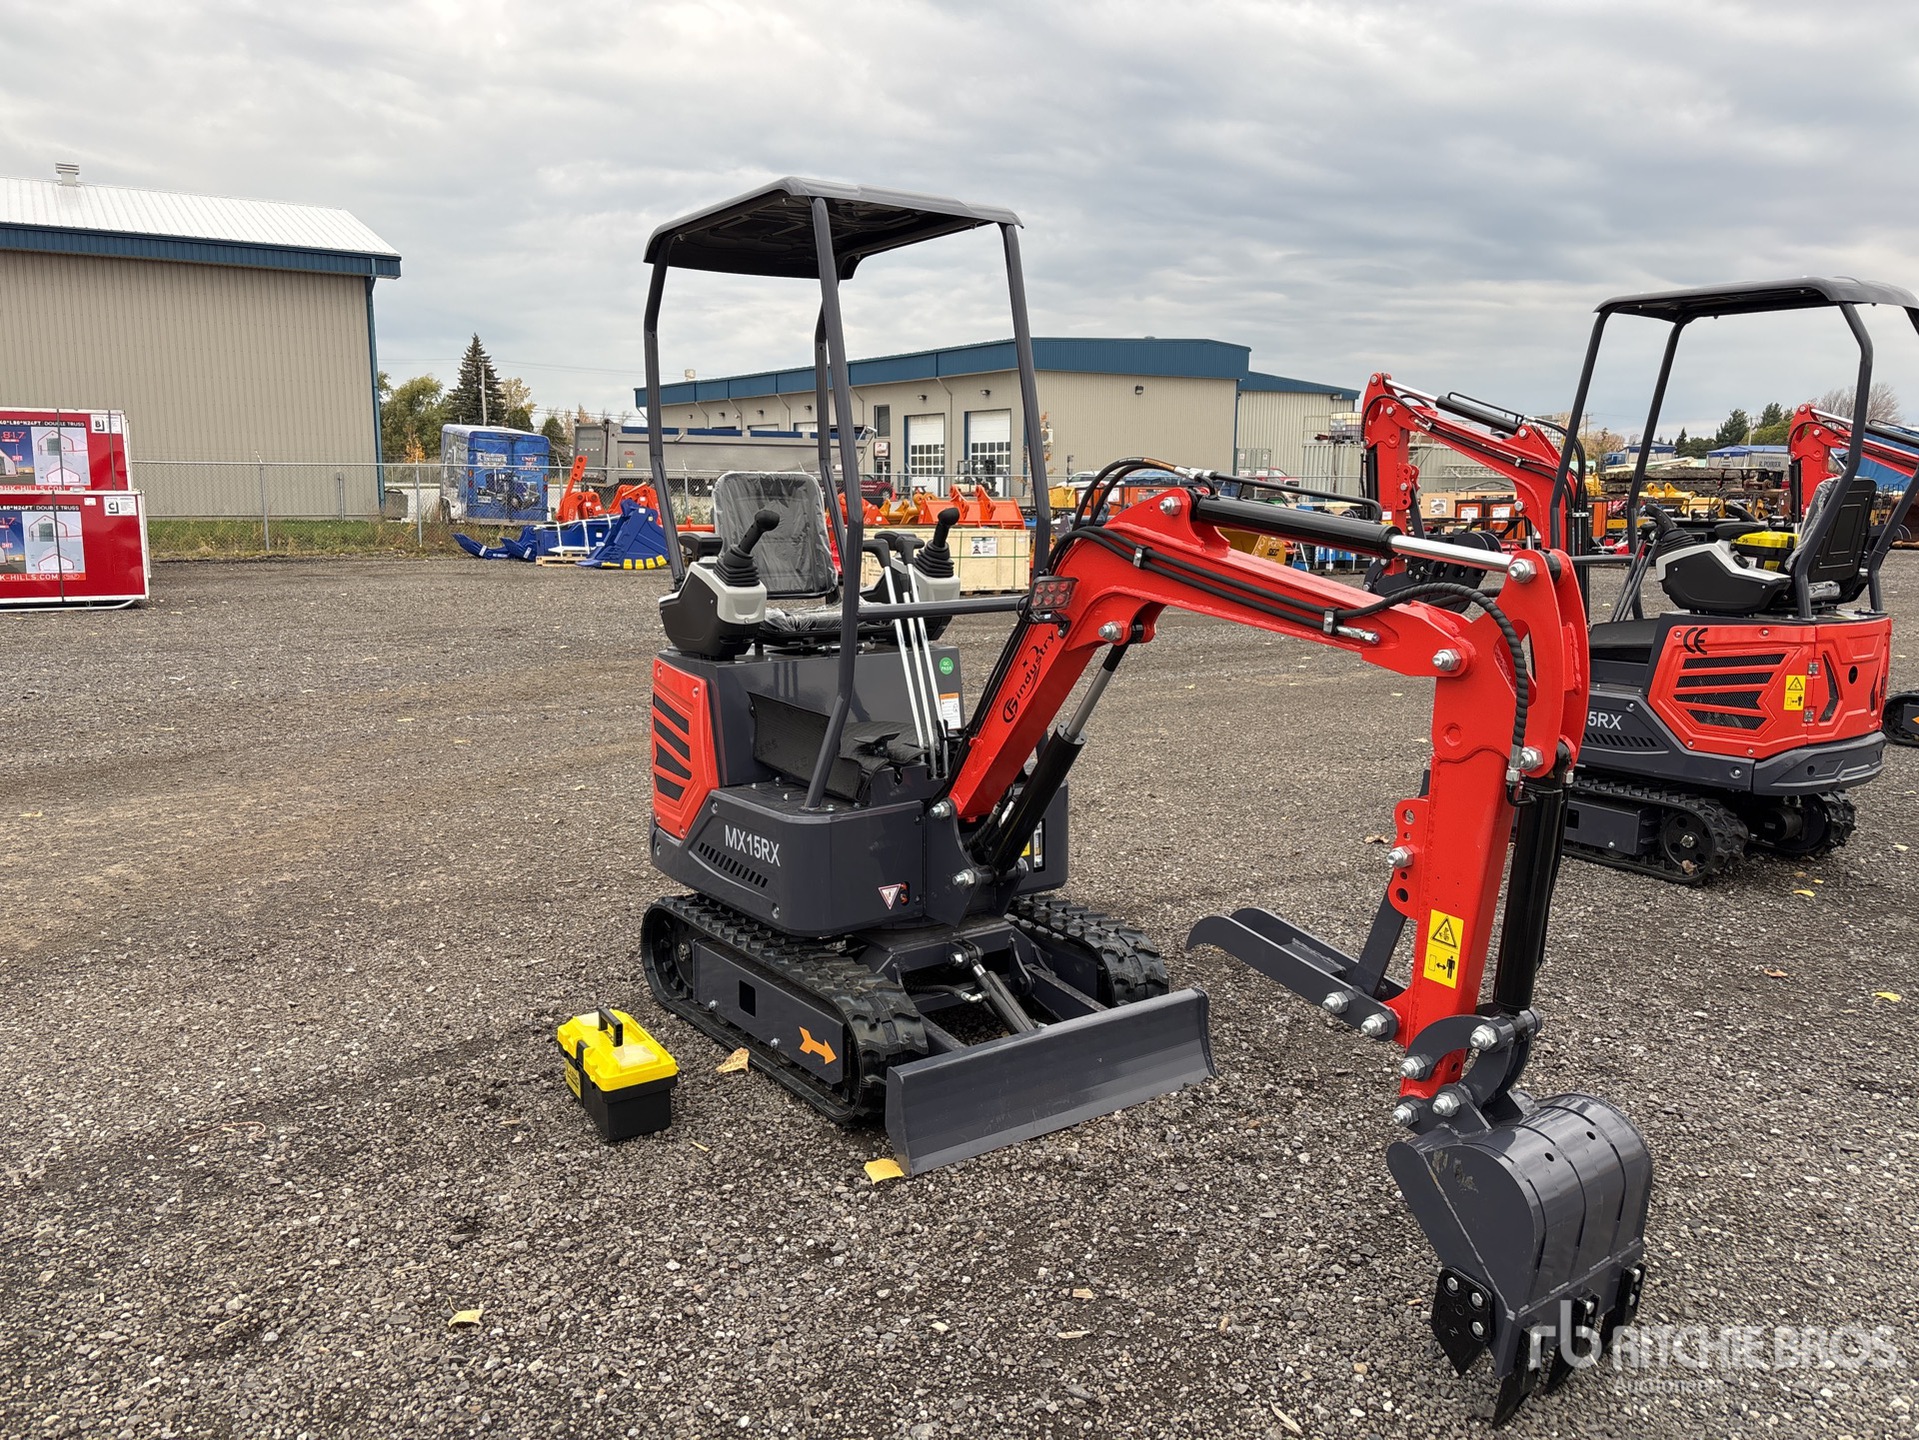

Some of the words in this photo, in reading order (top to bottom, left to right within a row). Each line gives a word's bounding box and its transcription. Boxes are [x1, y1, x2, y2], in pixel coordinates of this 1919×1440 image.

[108, 502, 115, 510] C
[1683, 627, 1708, 655] CE
[1588, 710, 1622, 731] 5RX
[724, 824, 781, 867] MX15RX
